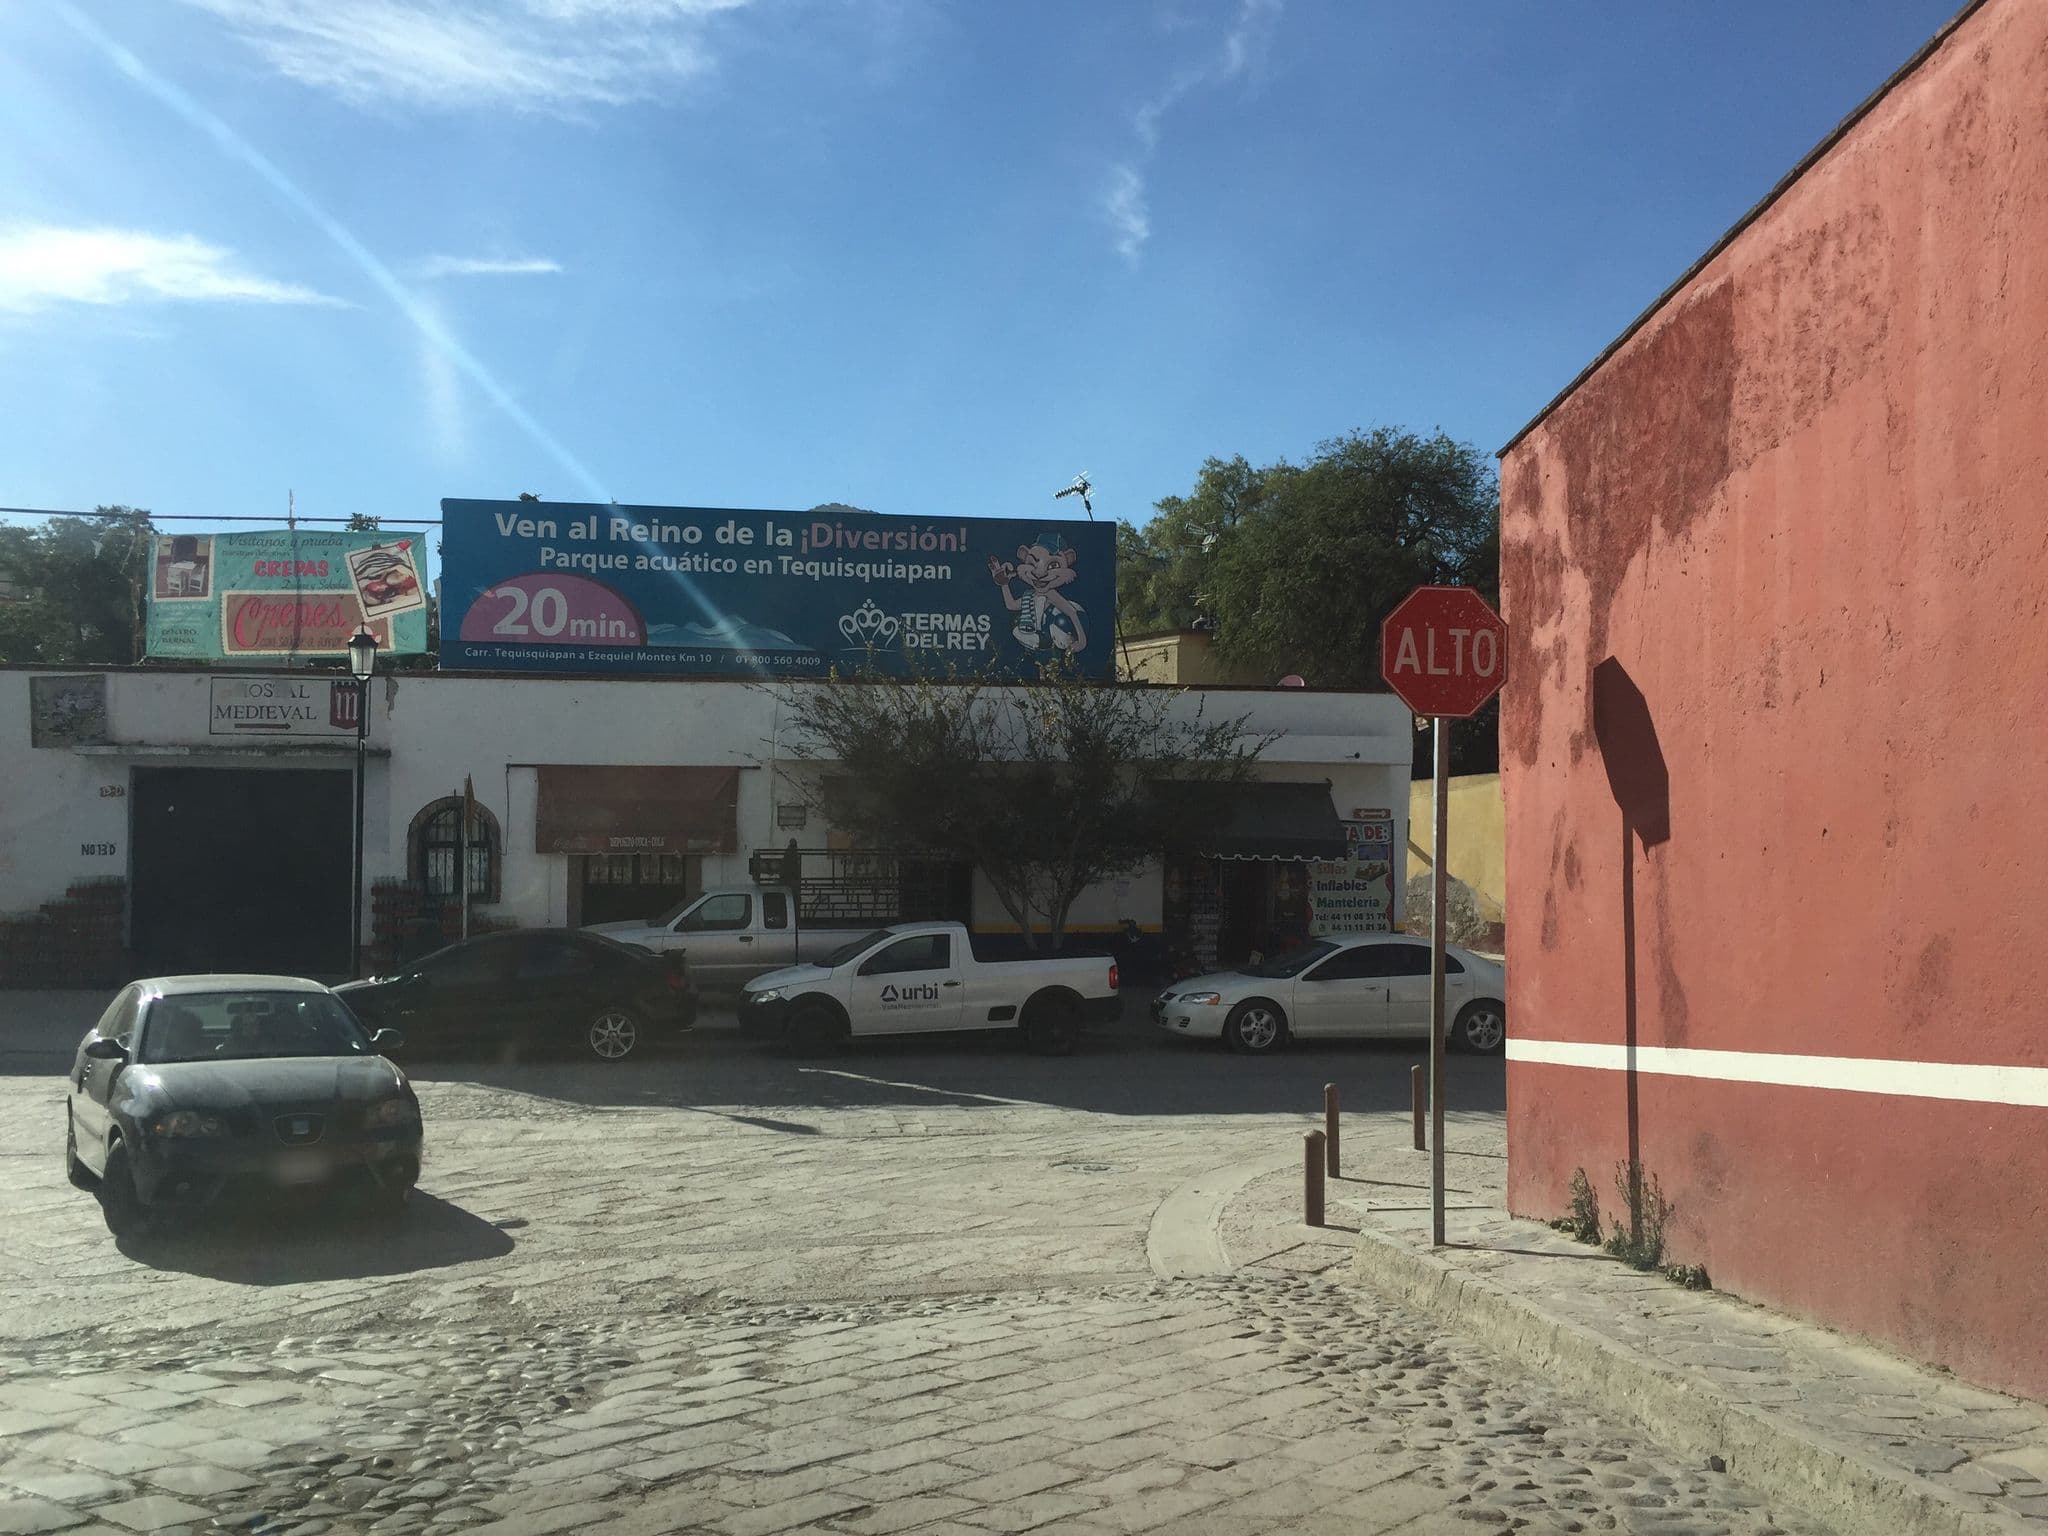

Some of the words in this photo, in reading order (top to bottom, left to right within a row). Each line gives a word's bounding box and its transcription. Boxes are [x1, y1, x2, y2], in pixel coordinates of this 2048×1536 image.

[495, 513, 557, 538] Ven
[568, 515, 597, 541] al
[609, 518, 703, 544] Reino
[715, 520, 753, 546] de
[766, 521, 793, 547] la
[801, 522, 968, 554] ¡Diversión!
[254, 560, 329, 577] CREPAS
[540, 547, 628, 574] Parque
[634, 551, 738, 574] acuático
[744, 559, 772, 575] en
[778, 555, 952, 584] Tequisquiapan
[233, 596, 346, 649] Crepes
[492, 586, 568, 637] 20
[570, 612, 636, 639] min.
[901, 612, 991, 632] TERMAS
[906, 632, 945, 650] DEL
[947, 632, 991, 650] REY
[464, 647, 492, 658] Carr.
[493, 648, 576, 662] Tequisquiapan
[588, 649, 634, 664] Ezequiel
[637, 651, 677, 663] Montes
[679, 652, 696, 663] Km
[699, 654, 712, 663] 10
[735, 654, 749, 665] 01
[751, 655, 771, 666] 800
[773, 656, 793, 666] 560
[795, 656, 821, 666] 4009
[1392, 627, 1497, 678] ALTO
[214, 704, 319, 720] MEDIEVAL
[902, 983, 939, 1000] urbi
